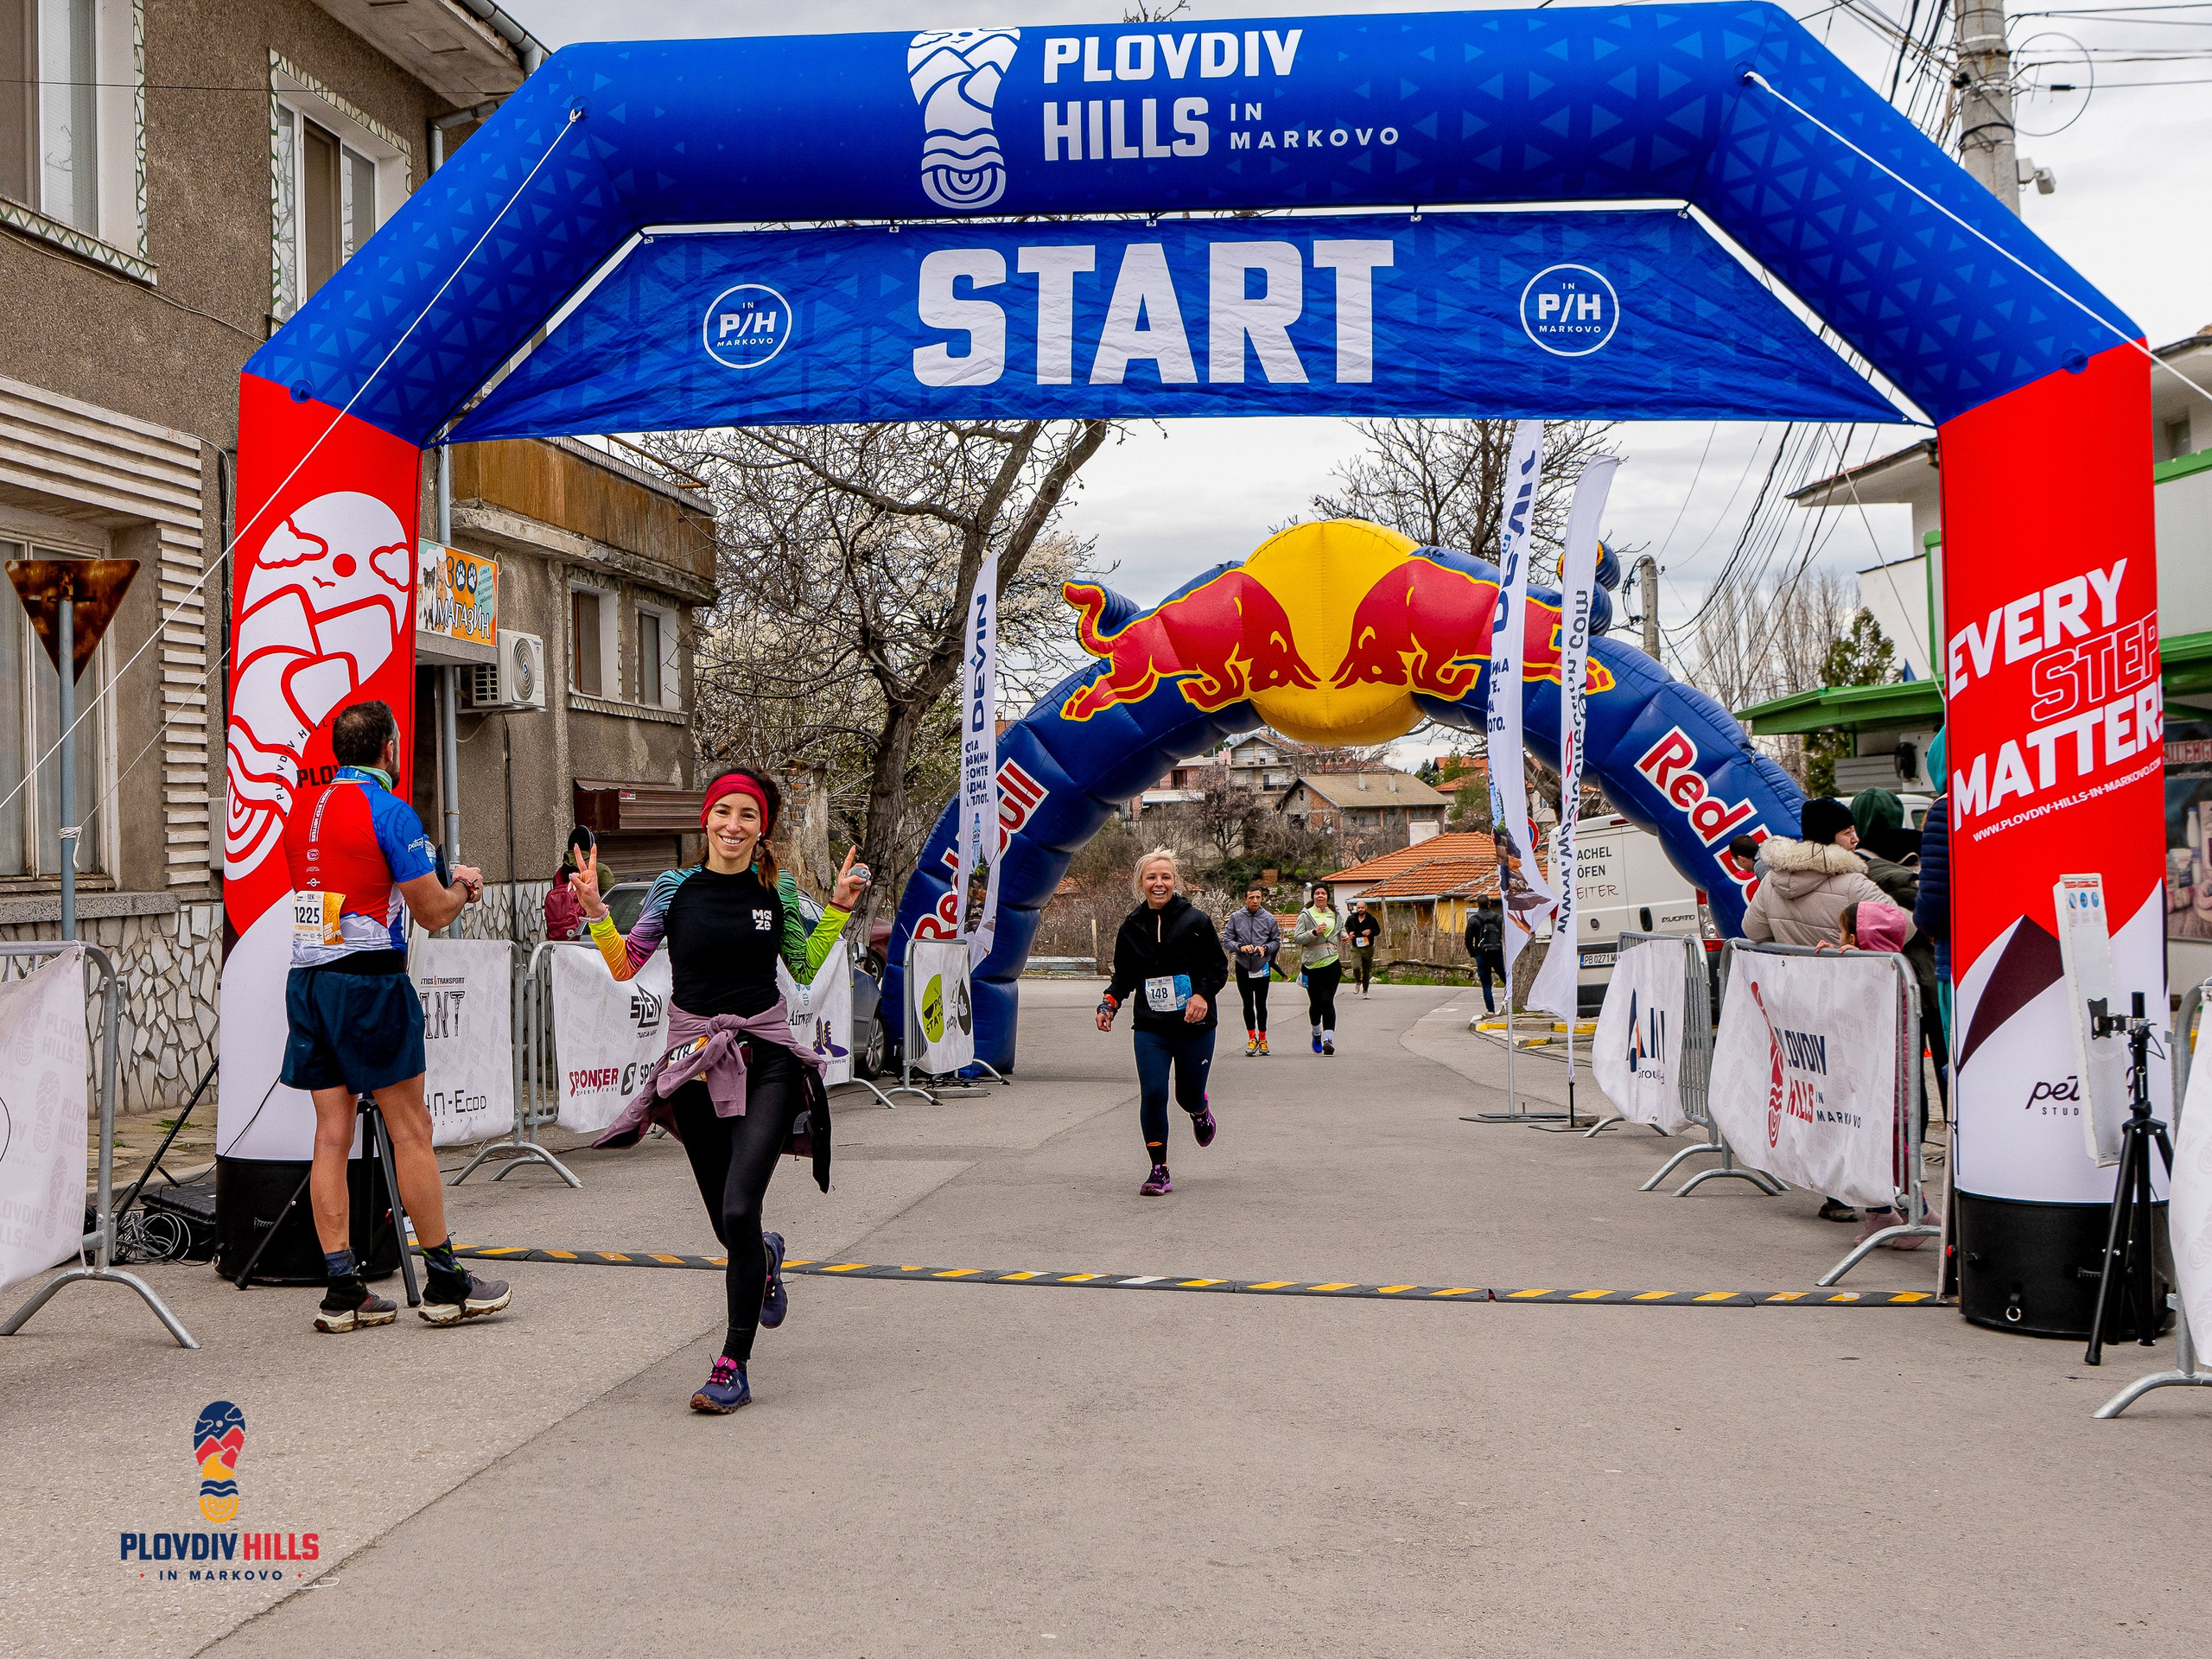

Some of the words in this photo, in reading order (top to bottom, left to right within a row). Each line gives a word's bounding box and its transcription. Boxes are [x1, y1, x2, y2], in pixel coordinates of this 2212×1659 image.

[1043, 29, 1304, 84] PLOVDIV
[1230, 103, 1262, 121] IN
[1044, 97, 1210, 162] HILLS
[1230, 127, 1400, 149] MARKOVO
[912, 239, 1395, 387] START
[1538, 292, 1601, 323] P/H
[719, 311, 777, 338] P/H
[1539, 325, 1602, 334] MARKOVO
[716, 336, 774, 346] MARKOVO
[436, 597, 491, 639] МАГАЗИН
[1948, 558, 2128, 701] EVERY
[972, 593, 988, 734] DEVIN
[2031, 608, 2159, 722] STEP
[276, 741, 296, 800] PLOVDIV
[296, 765, 340, 788] PLO
[1636, 728, 1755, 846] Red
[295, 906, 320, 925] 1225
[1151, 988, 1168, 1000] 148
[569, 1067, 620, 1098] SPONSER
